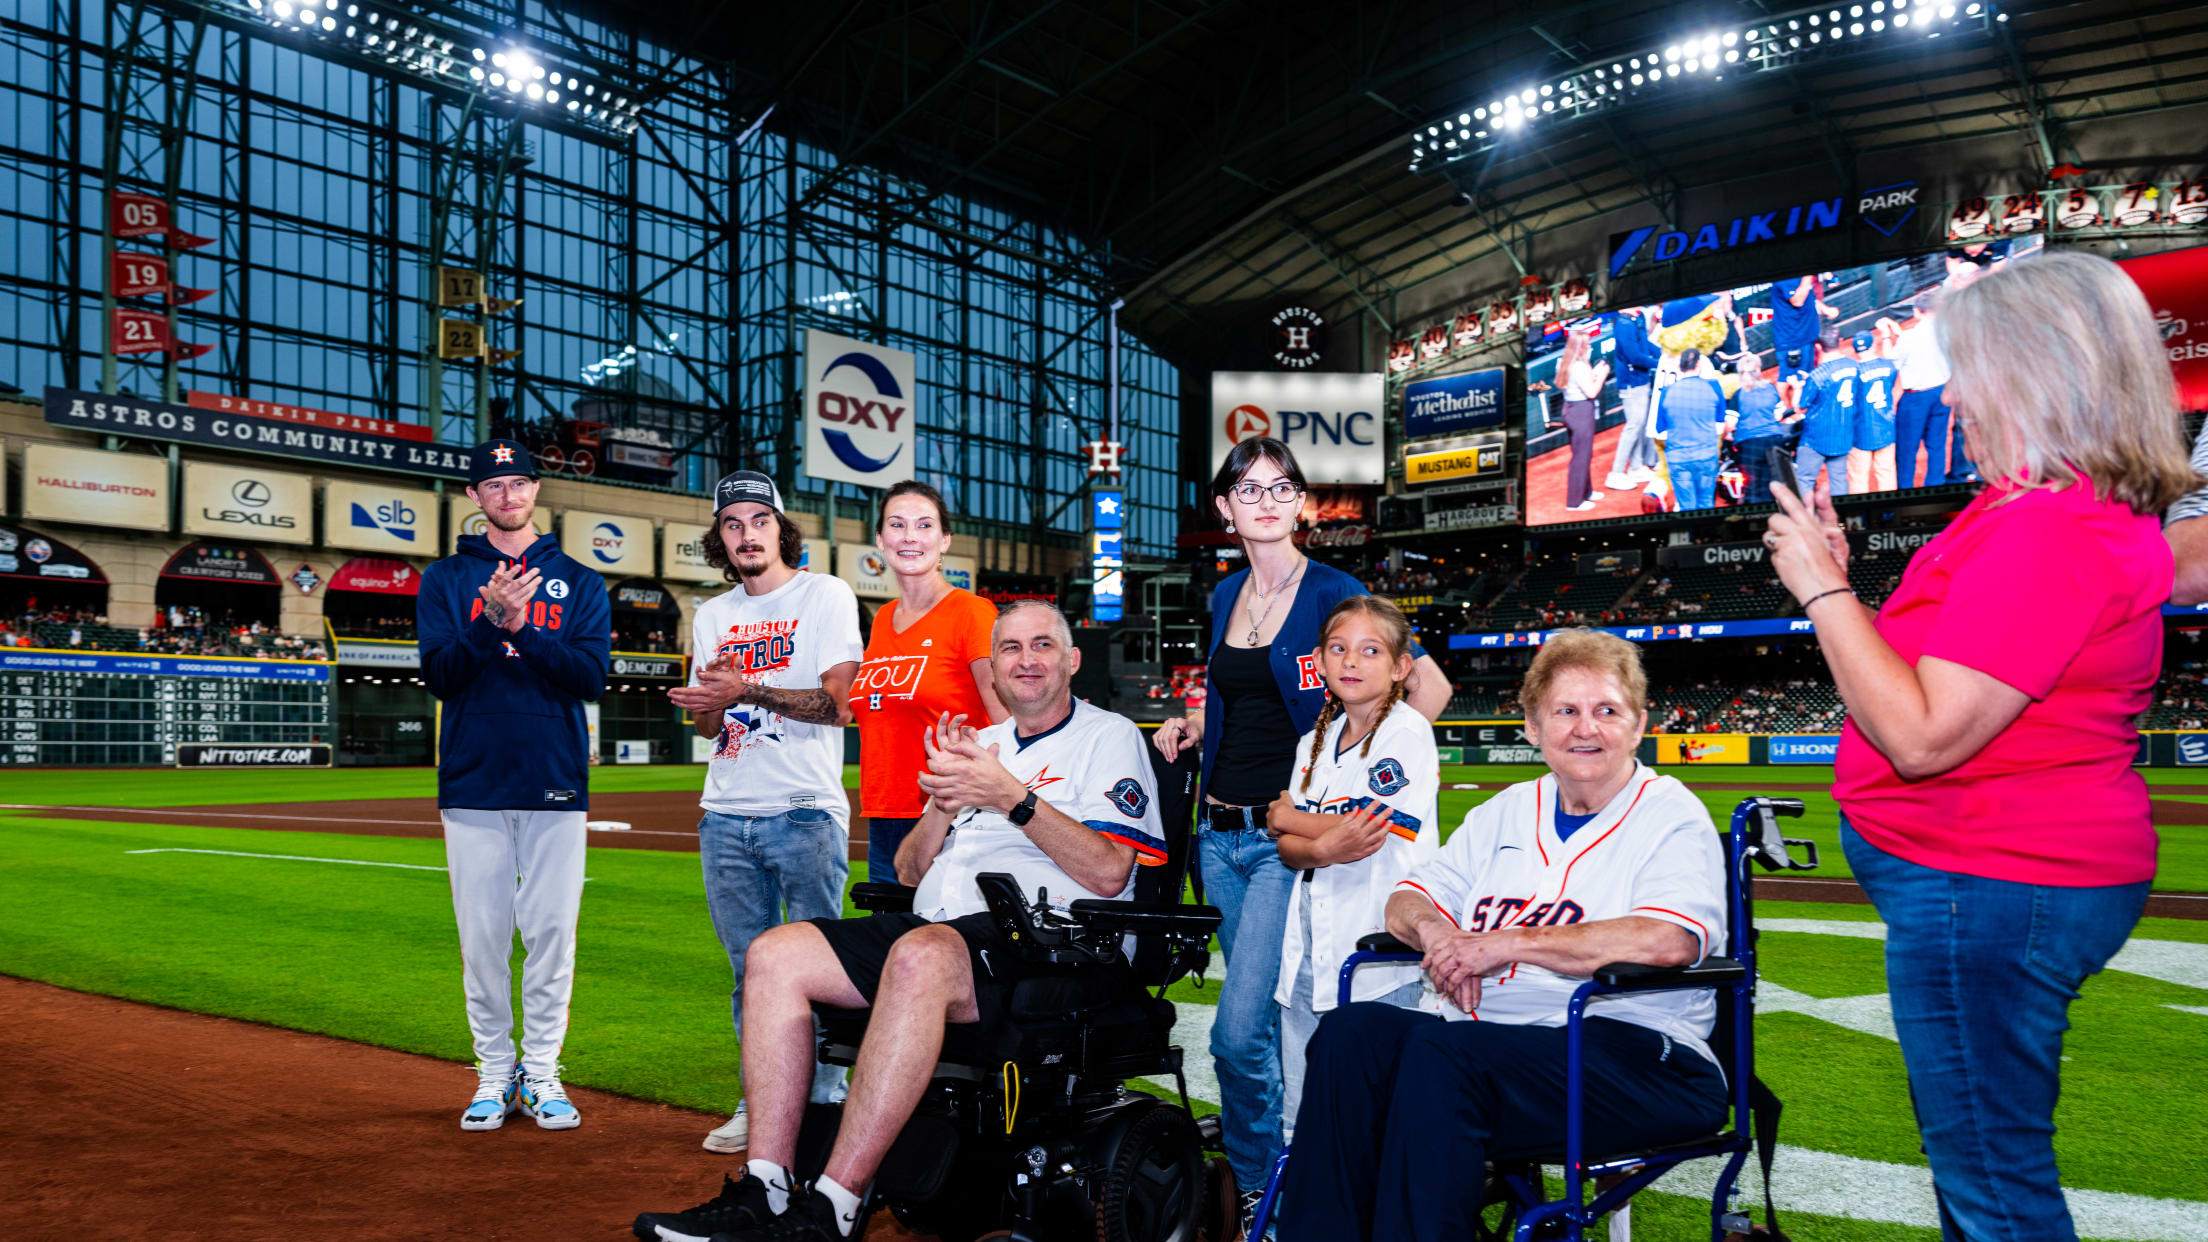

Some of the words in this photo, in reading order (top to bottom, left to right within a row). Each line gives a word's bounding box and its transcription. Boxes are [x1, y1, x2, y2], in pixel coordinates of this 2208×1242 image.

[1858, 188, 1920, 214] PARK
[2003, 190, 2041, 219] 24
[2067, 187, 2086, 212] 5
[2124, 182, 2147, 209] 7
[123, 203, 158, 226] 05
[1952, 196, 1988, 222] 49
[1653, 197, 1843, 263] DAIKIN
[126, 264, 158, 285] 19
[450, 278, 474, 297] 17
[1272, 307, 1324, 326] HOUSTON
[1489, 299, 1513, 321] 33
[124, 321, 155, 340] 21
[1454, 312, 1478, 334] 25
[449, 331, 474, 348] 22
[1287, 327, 1310, 349] H
[1420, 325, 1447, 346] 40
[1274, 352, 1321, 368] ASTROS
[1411, 389, 1496, 418] Methodist
[1837, 379, 1854, 408] 4
[1866, 380, 1887, 409] 4
[220, 398, 317, 422] DAIKIN
[336, 416, 396, 434] PARK
[818, 391, 906, 433] OXY
[69, 399, 196, 432] ASTROS
[211, 420, 396, 459] COMMUNITY
[1277, 411, 1375, 446] PNC
[493, 447, 515, 465] H
[1089, 441, 1121, 472] H
[1418, 456, 1472, 474] MUSTANG
[1479, 451, 1500, 468] CAT
[37, 476, 156, 498] HALLIBURTON
[203, 508, 296, 529] LEXUS
[376, 500, 416, 525] slb
[1438, 506, 1506, 528] HARGROVE
[593, 537, 623, 548] OXY
[676, 540, 704, 557] reli
[1704, 546, 1765, 565] Chevy
[350, 577, 391, 588] equinor
[550, 581, 562, 597] 4
[618, 588, 644, 602] SPACE
[645, 590, 664, 604] CITY
[978, 590, 1057, 604] Budweiser
[1626, 629, 1646, 639] PIT
[1698, 625, 1724, 635] HOU
[1790, 621, 1812, 631] PIT
[1480, 636, 1499, 646] PIT
[339, 652, 356, 660] ANK
[626, 661, 671, 676] EMCJET
[852, 664, 916, 690] HOU
[1297, 655, 1325, 690] R
[397, 721, 422, 732] 366
[200, 747, 312, 765] NITTOTIRE.COM
[1488, 749, 1513, 762] SPACE
[1514, 749, 1534, 762] CITY
[1790, 744, 1839, 755] HON
